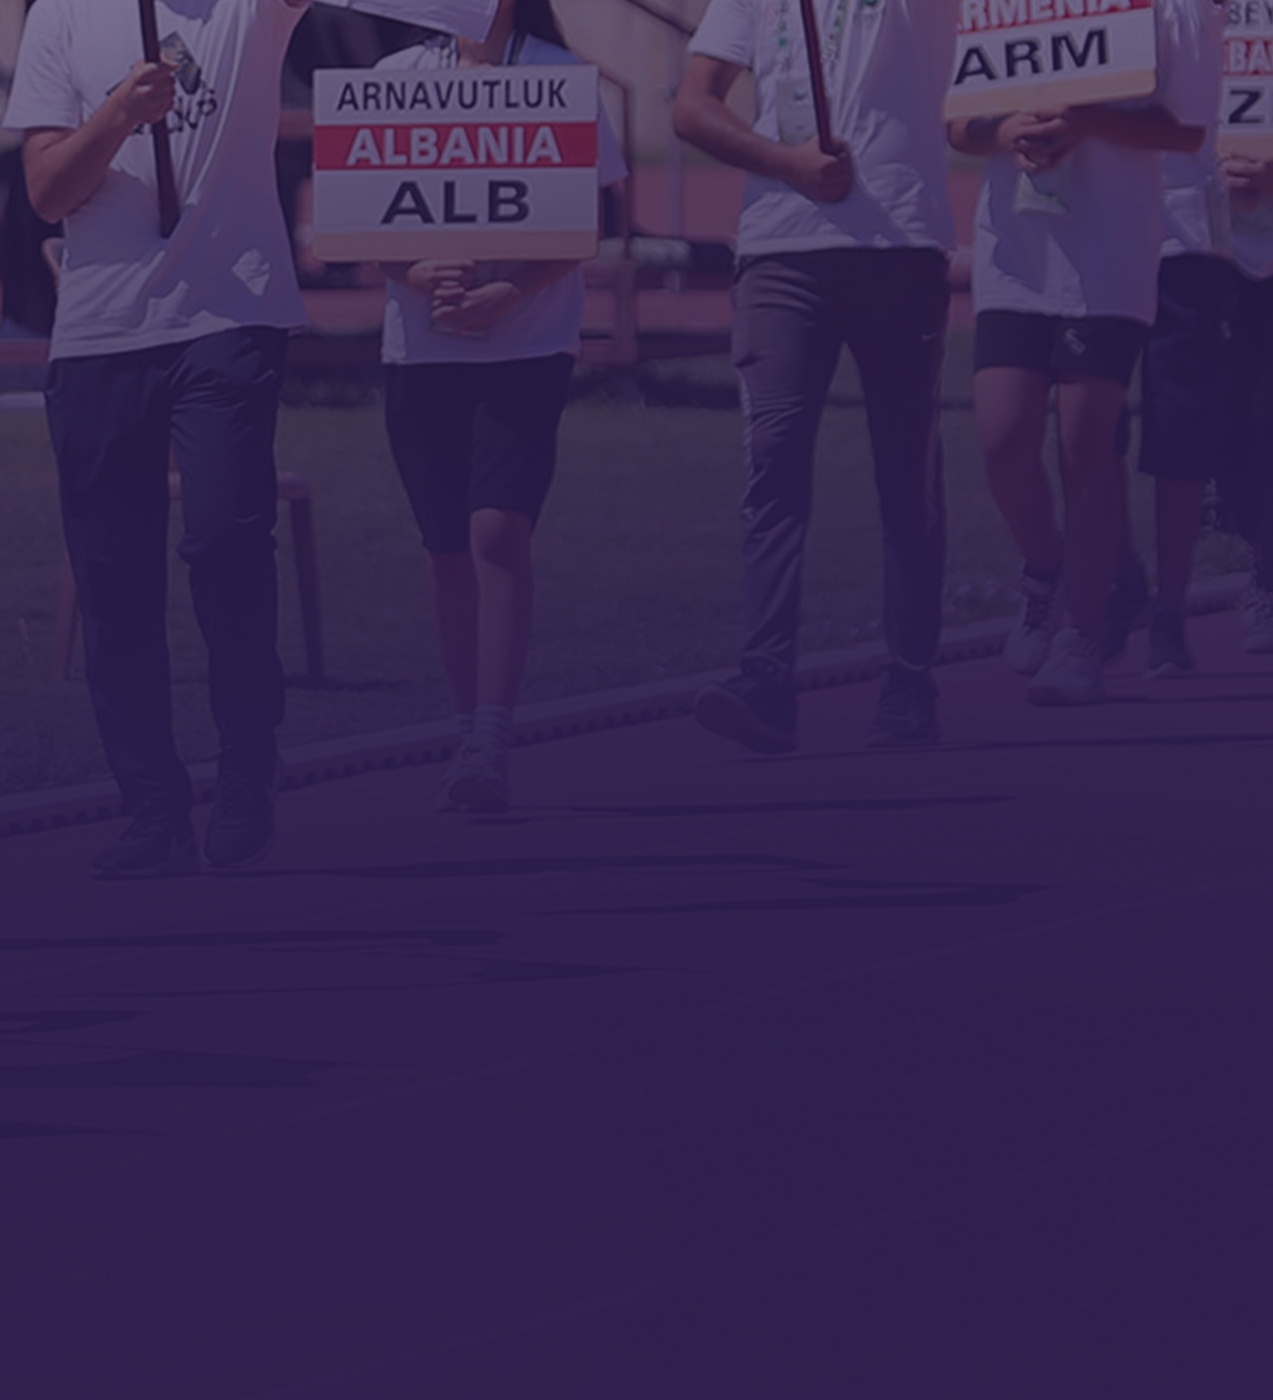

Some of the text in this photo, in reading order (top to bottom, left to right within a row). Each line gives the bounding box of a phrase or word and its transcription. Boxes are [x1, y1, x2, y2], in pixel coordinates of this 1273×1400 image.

[953, 25, 1110, 86] ARM
[335, 76, 569, 113] ARNAVUTLUK
[346, 124, 563, 167] ALBANIA
[379, 178, 532, 226] ALB
